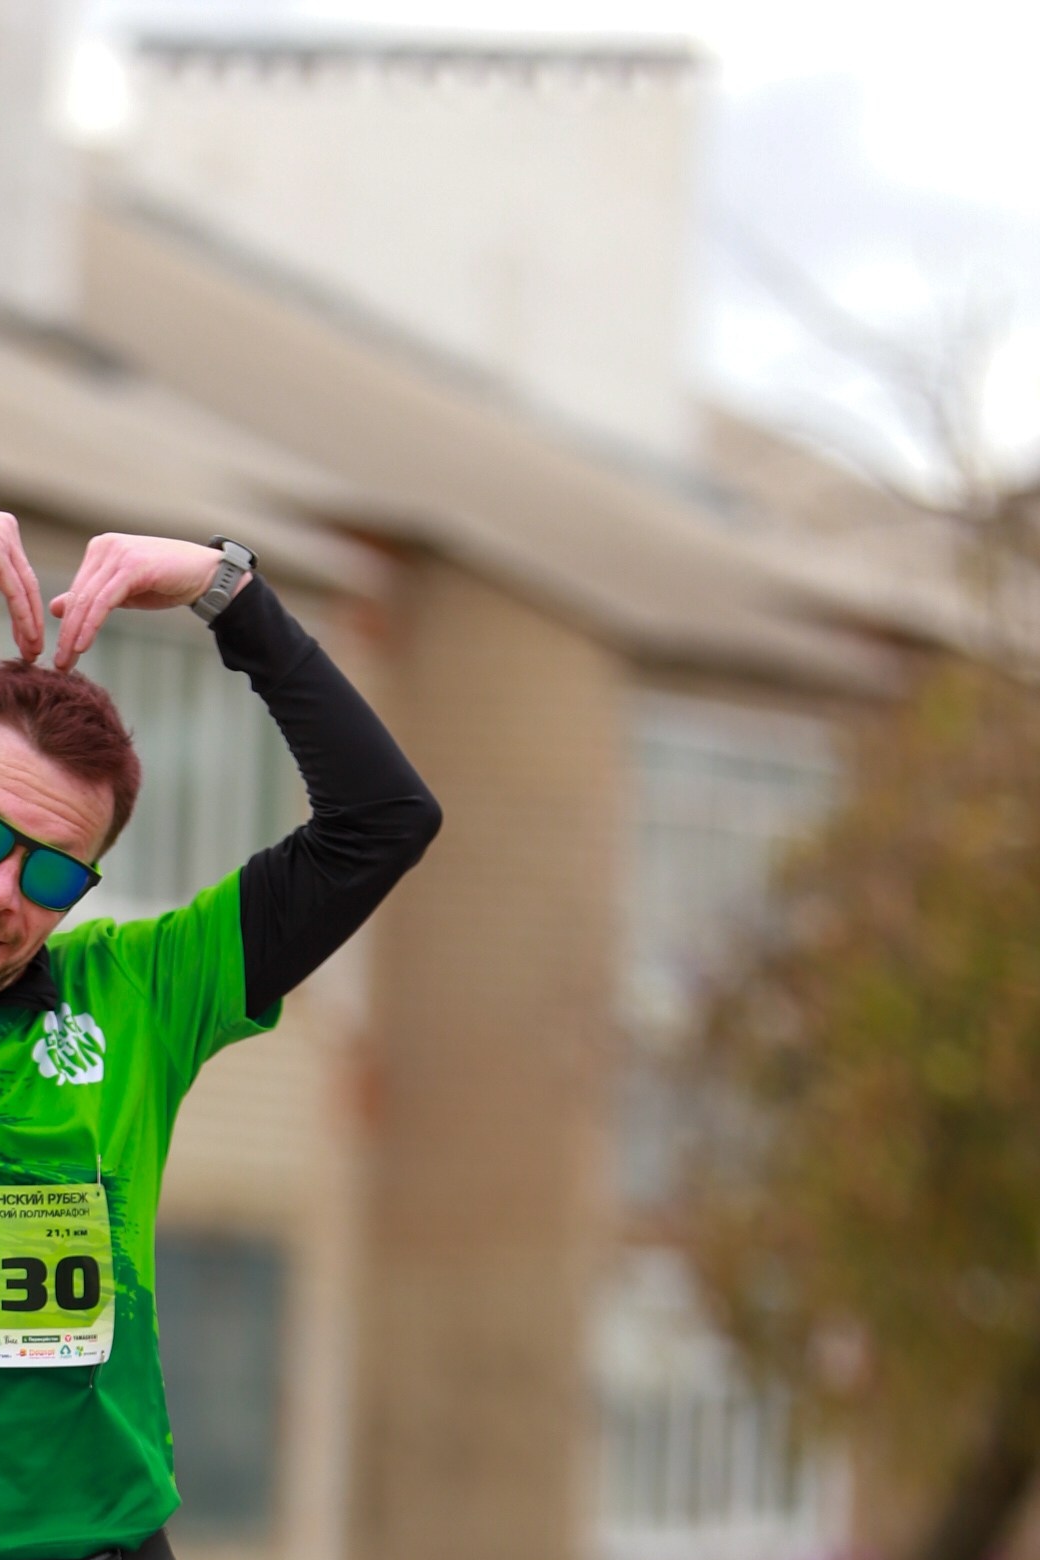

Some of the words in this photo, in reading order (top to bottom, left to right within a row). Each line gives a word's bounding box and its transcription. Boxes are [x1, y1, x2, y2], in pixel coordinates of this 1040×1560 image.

[48, 1191, 89, 1205] РУБЕЖ
[19, 1208, 91, 1219] ПОЛУМАРАФОН
[46, 1228, 71, 1239] 21,1
